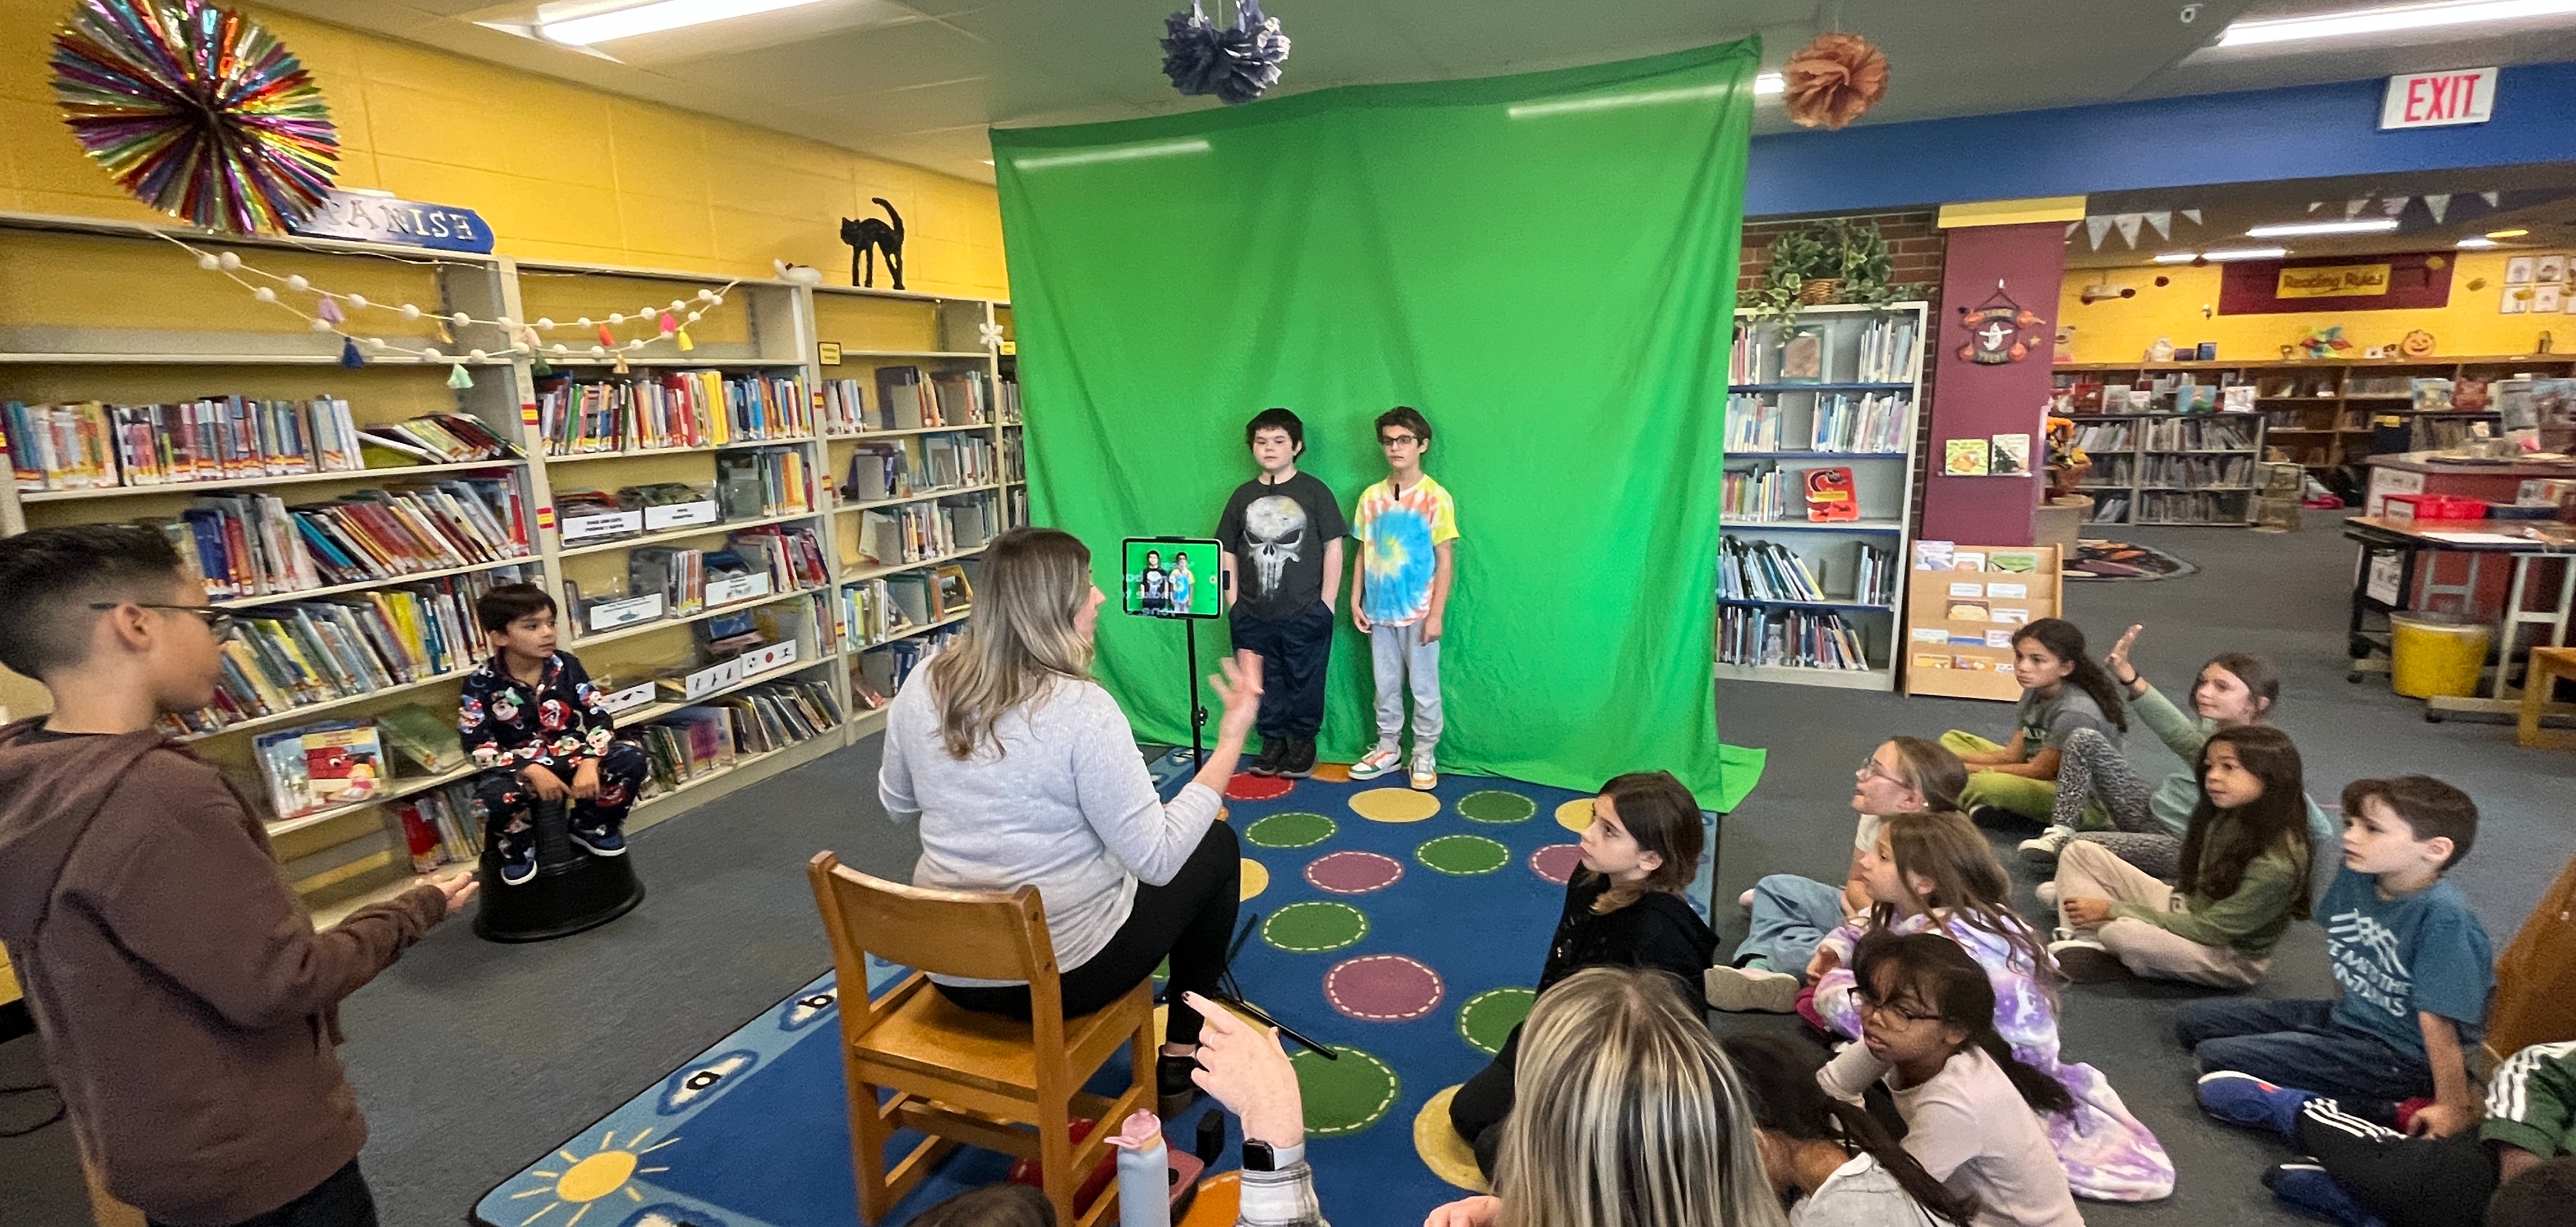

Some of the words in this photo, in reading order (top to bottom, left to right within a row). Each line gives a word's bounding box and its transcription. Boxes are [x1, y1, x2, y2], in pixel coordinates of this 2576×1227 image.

[2405, 75, 2481, 121] EXIT
[321, 199, 475, 241] PANISH
[2345, 272, 2384, 286] Rules
[797, 994, 835, 1010] b
